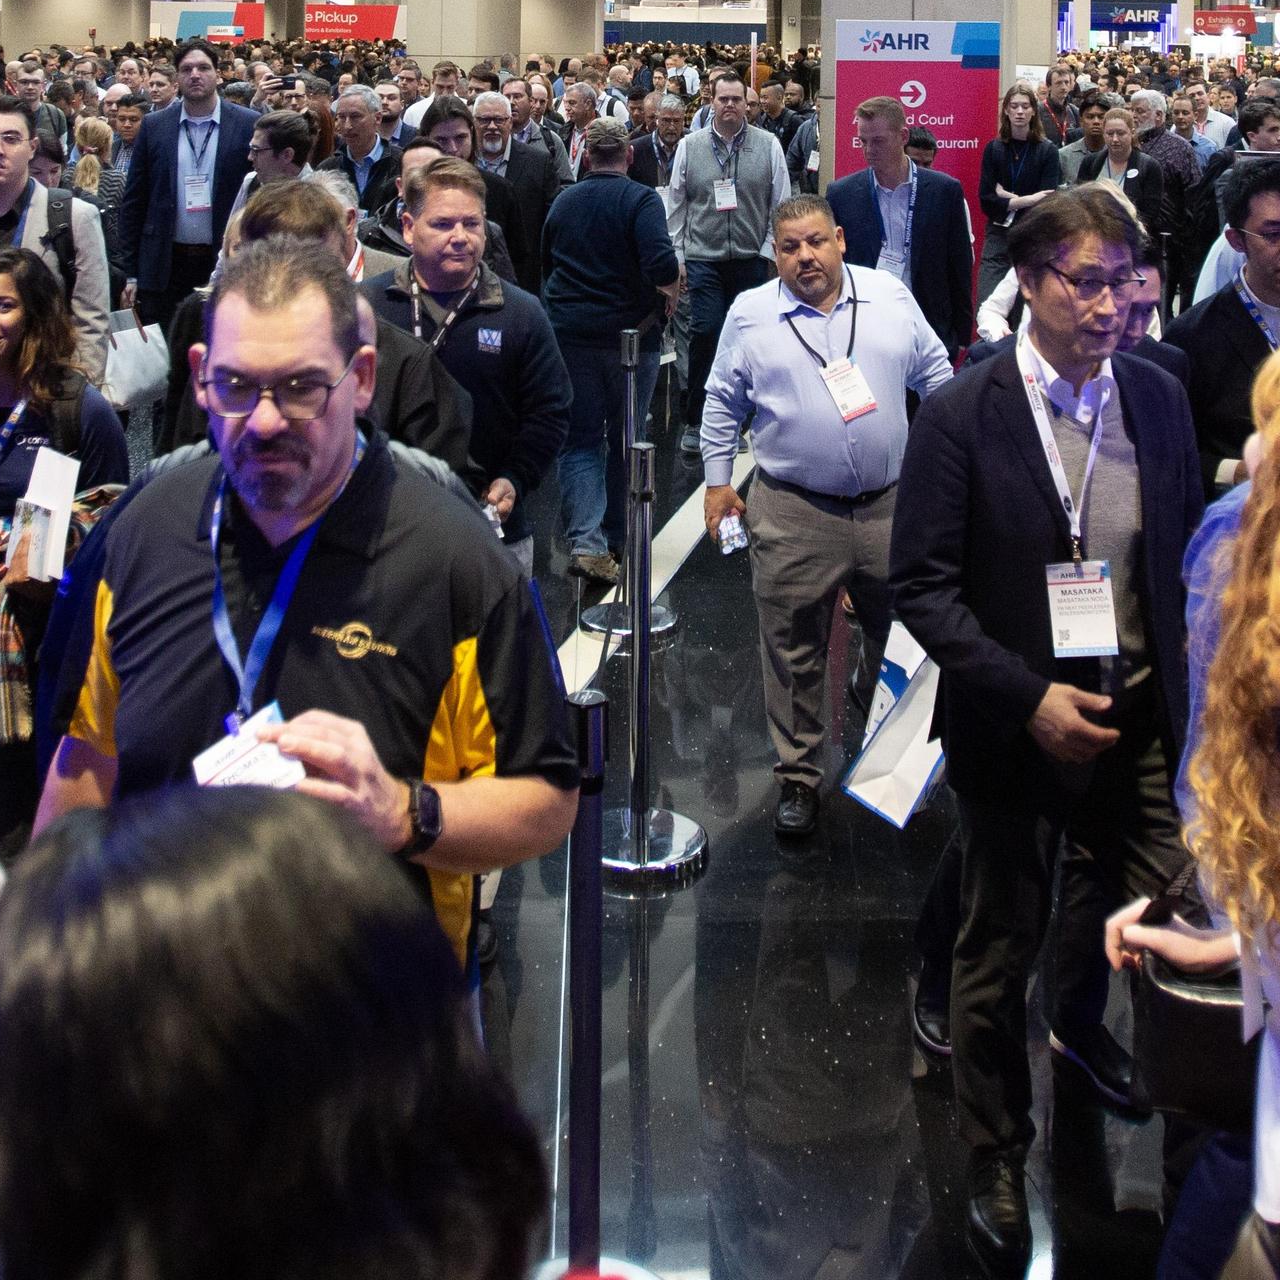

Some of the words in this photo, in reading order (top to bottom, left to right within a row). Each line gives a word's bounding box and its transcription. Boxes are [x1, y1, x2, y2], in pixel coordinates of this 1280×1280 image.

[315, 11, 359, 25] Pickup
[1124, 9, 1160, 23] AHR
[880, 33, 930, 50] AHR
[918, 113, 954, 125] Court
[1061, 587, 1104, 596] MASATAKA
